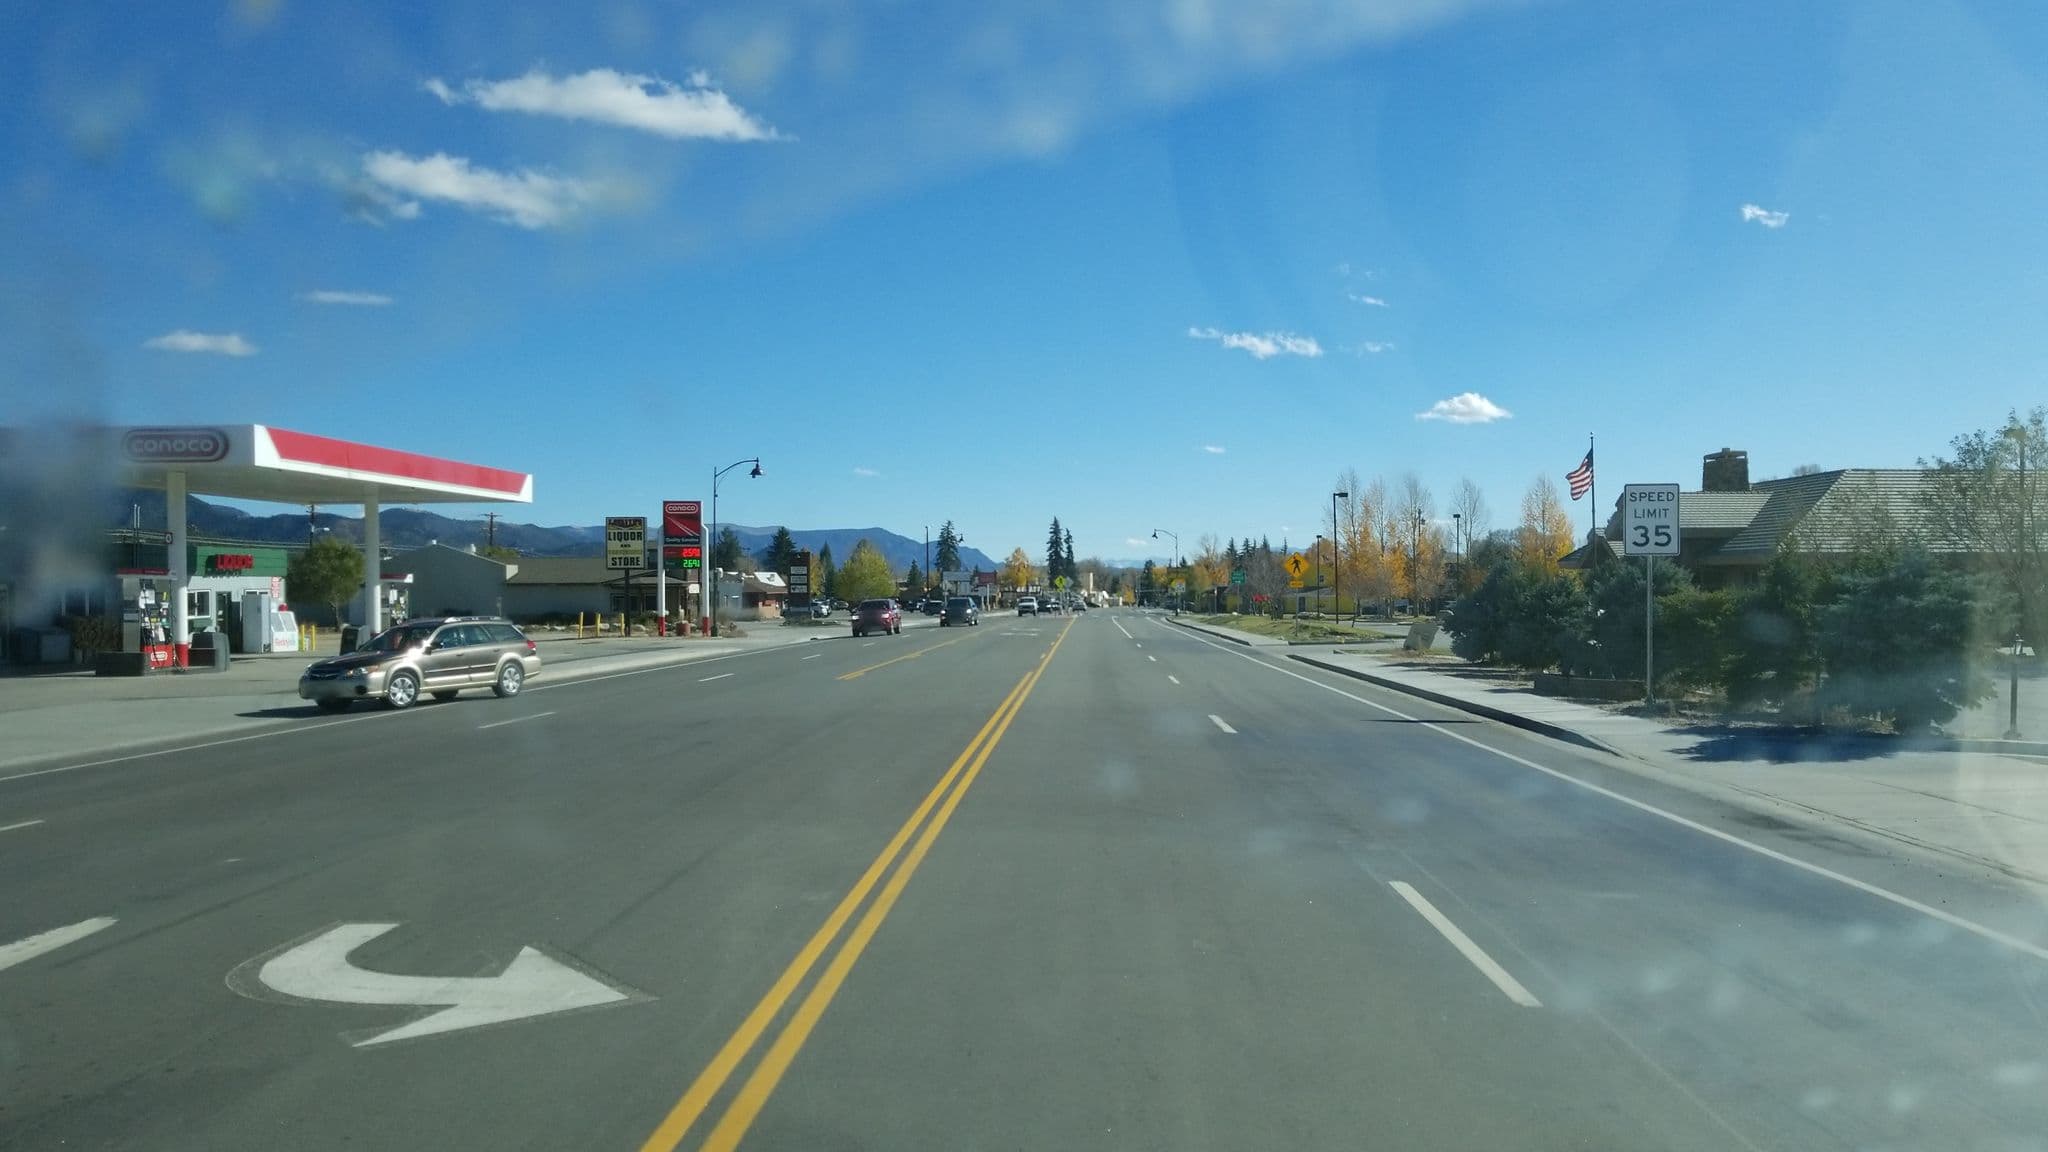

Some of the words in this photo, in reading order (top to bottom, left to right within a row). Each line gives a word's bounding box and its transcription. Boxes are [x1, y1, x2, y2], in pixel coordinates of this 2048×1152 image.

[1629, 491, 1675, 502] SPEED
[1634, 508, 1669, 519] LIMIT
[608, 531, 642, 542] LIQUOR
[1632, 524, 1672, 547] 35
[611, 556, 641, 566] STORE
